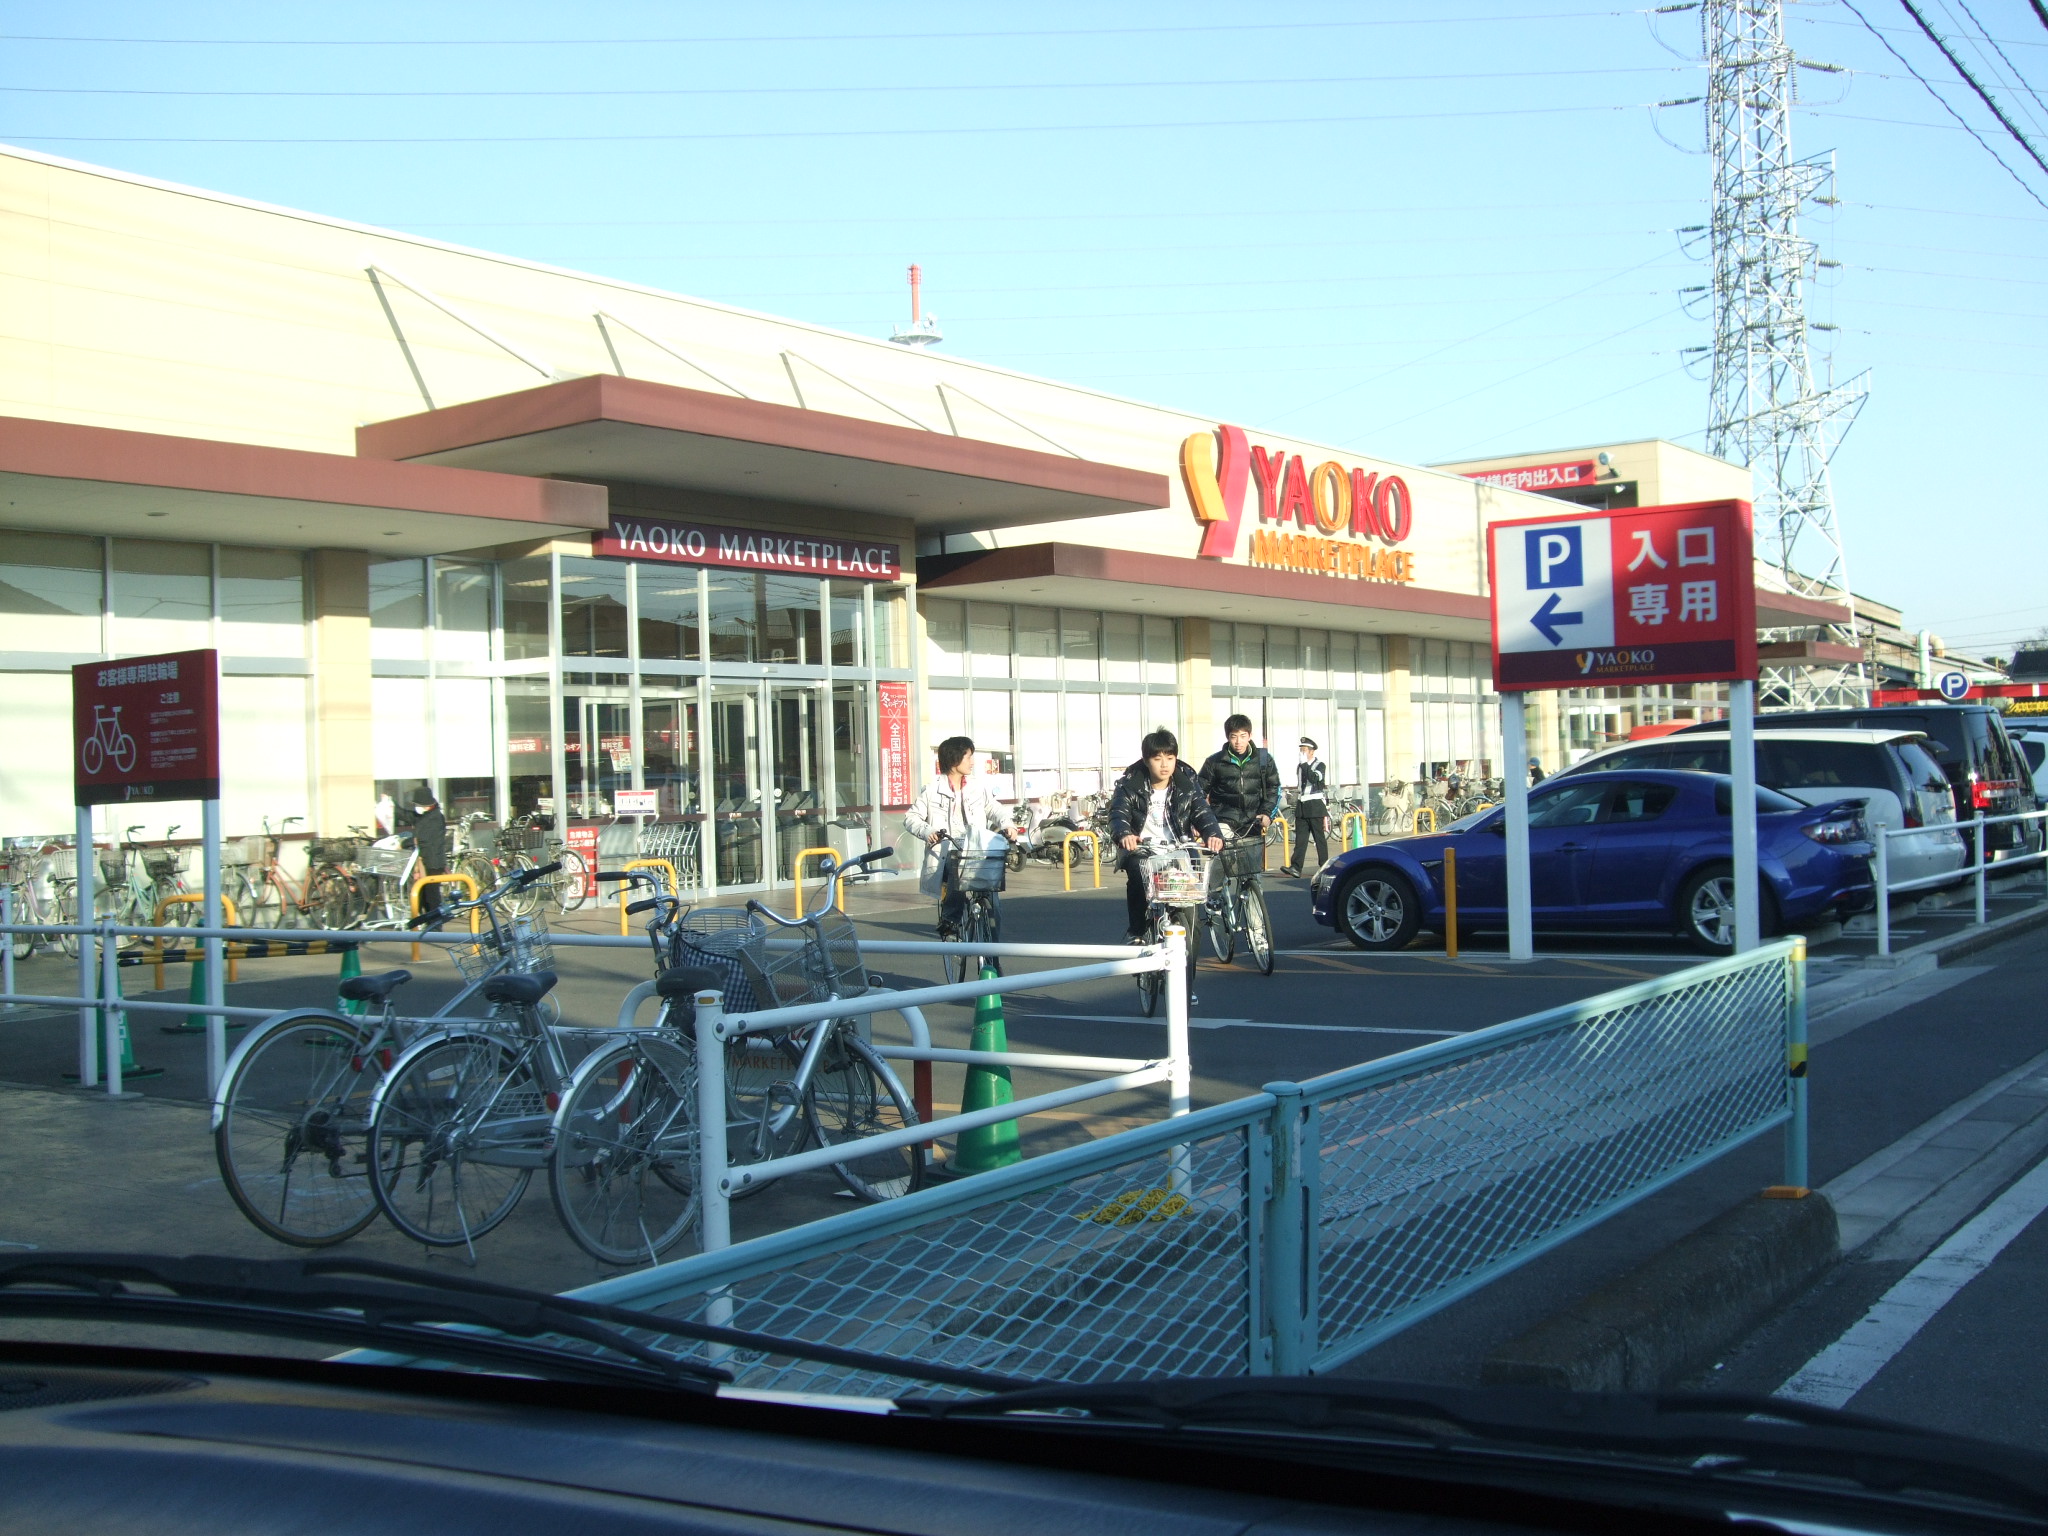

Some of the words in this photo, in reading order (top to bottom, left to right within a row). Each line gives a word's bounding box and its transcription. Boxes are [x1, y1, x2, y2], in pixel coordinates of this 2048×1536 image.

[1251, 445, 1412, 542] YAOKO
[615, 522, 706, 557] YAOKO
[718, 533, 892, 575] MARKETPLACE
[1254, 529, 1416, 582] MARKETPLACE
[1539, 534, 1571, 584] P
[1627, 526, 1716, 572] 入口
[1628, 580, 1718, 626] 専用
[97, 661, 179, 687] お客様専用駐輪場
[1596, 650, 1655, 666] YAOKO
[1596, 663, 1656, 674] MARKETPLACE
[1946, 675, 1964, 696] P
